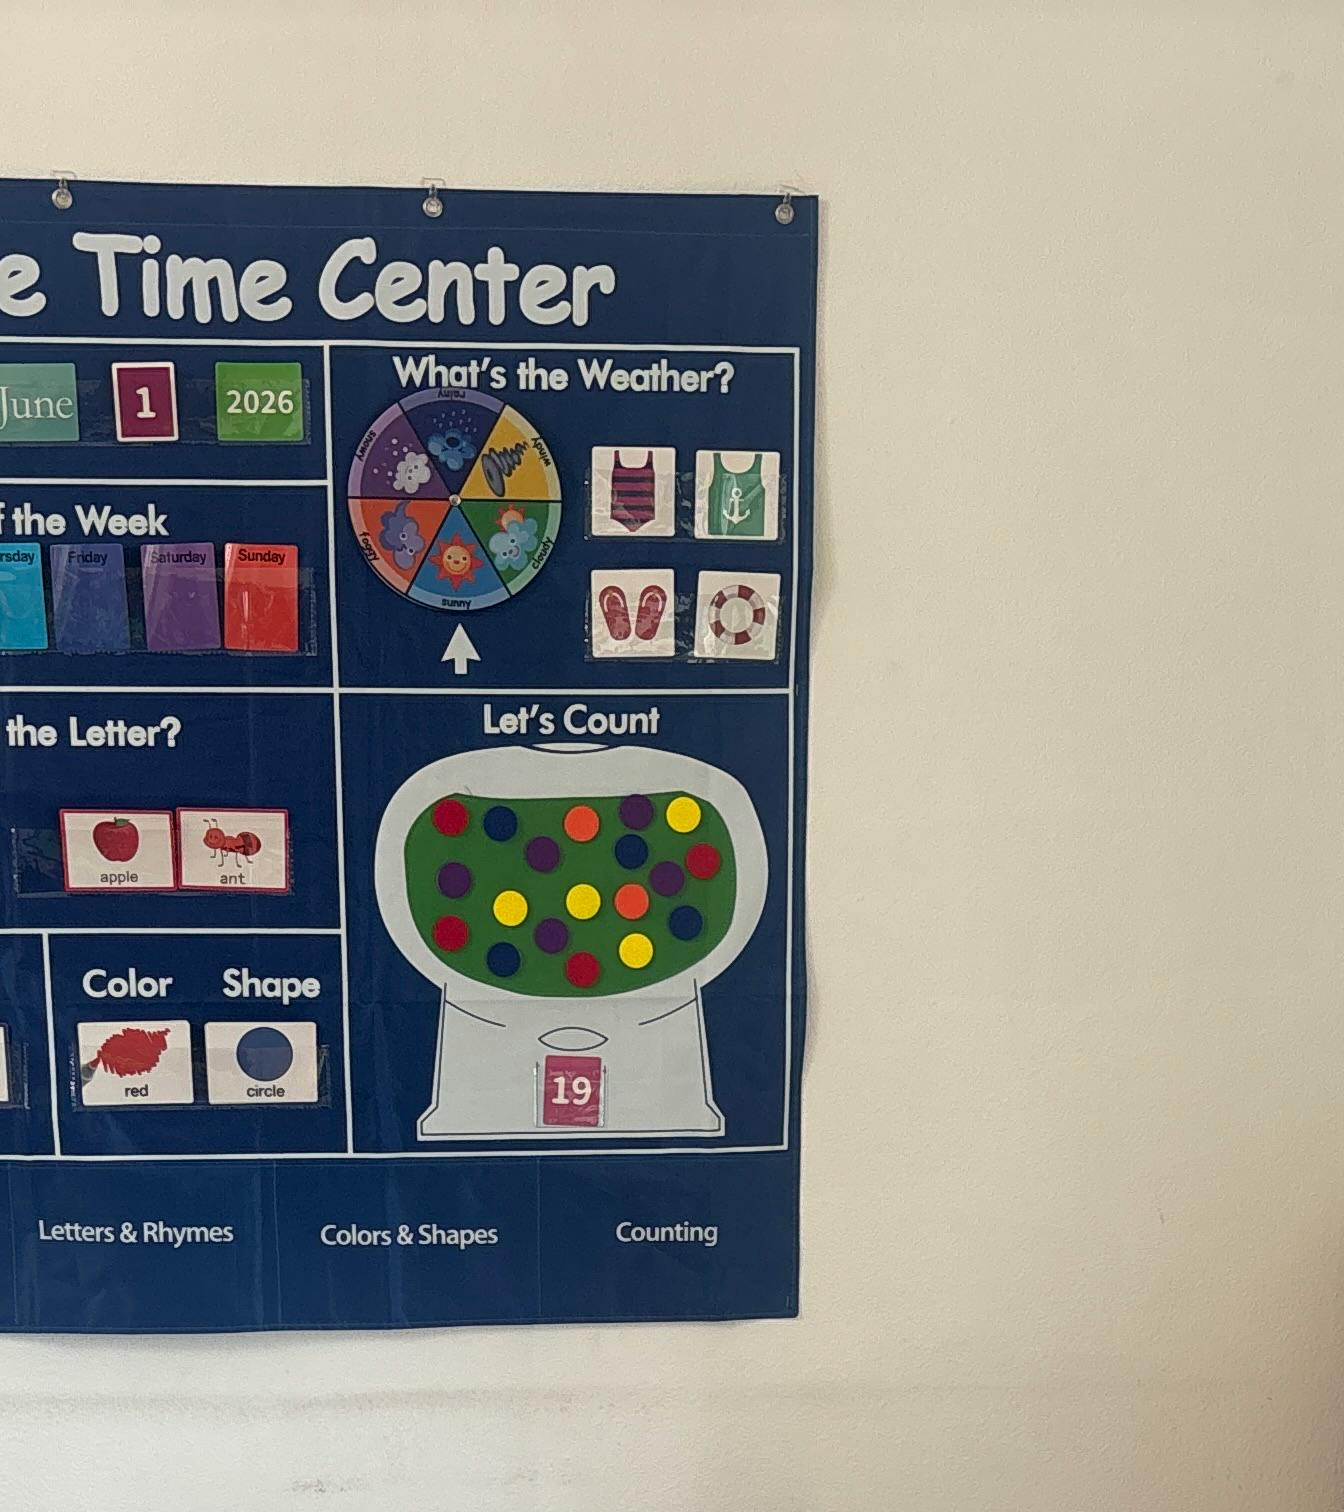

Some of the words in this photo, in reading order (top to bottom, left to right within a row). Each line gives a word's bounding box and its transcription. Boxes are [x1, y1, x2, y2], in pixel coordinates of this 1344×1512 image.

[72, 232, 293, 323] Time
[317, 236, 616, 327] Center
[392, 354, 506, 390] What's
[517, 359, 569, 391] the
[577, 359, 735, 394] Weather?
[135, 386, 156, 419] 1
[226, 390, 294, 415] 2026
[438, 389, 466, 399] rainy
[356, 430, 376, 462] snowy
[531, 437, 552, 468] windy
[11, 503, 67, 537] the
[75, 505, 168, 537] Week
[67, 550, 108, 568] Friday
[150, 549, 207, 567] Saturday
[238, 548, 285, 566] Sunday
[359, 531, 380, 564] foggy
[532, 537, 554, 571] cloudy
[442, 599, 472, 610] sunny
[6, 715, 57, 748] the
[69, 716, 182, 749] Letter?
[483, 704, 555, 735] Let's
[562, 704, 660, 736] Count
[99, 870, 139, 886] apple
[220, 872, 246, 886] ant
[81, 968, 174, 999] Color
[222, 968, 321, 1005] Shape
[124, 1084, 149, 1098] red
[246, 1084, 285, 1099] circle
[550, 1076, 593, 1105] 19
[38, 1220, 114, 1244] Letters
[119, 1222, 139, 1244] &
[142, 1222, 234, 1248] Rhymes
[320, 1224, 392, 1247] Colors
[396, 1225, 415, 1246] &
[418, 1224, 499, 1249] Shapes
[615, 1222, 719, 1248] Counting
